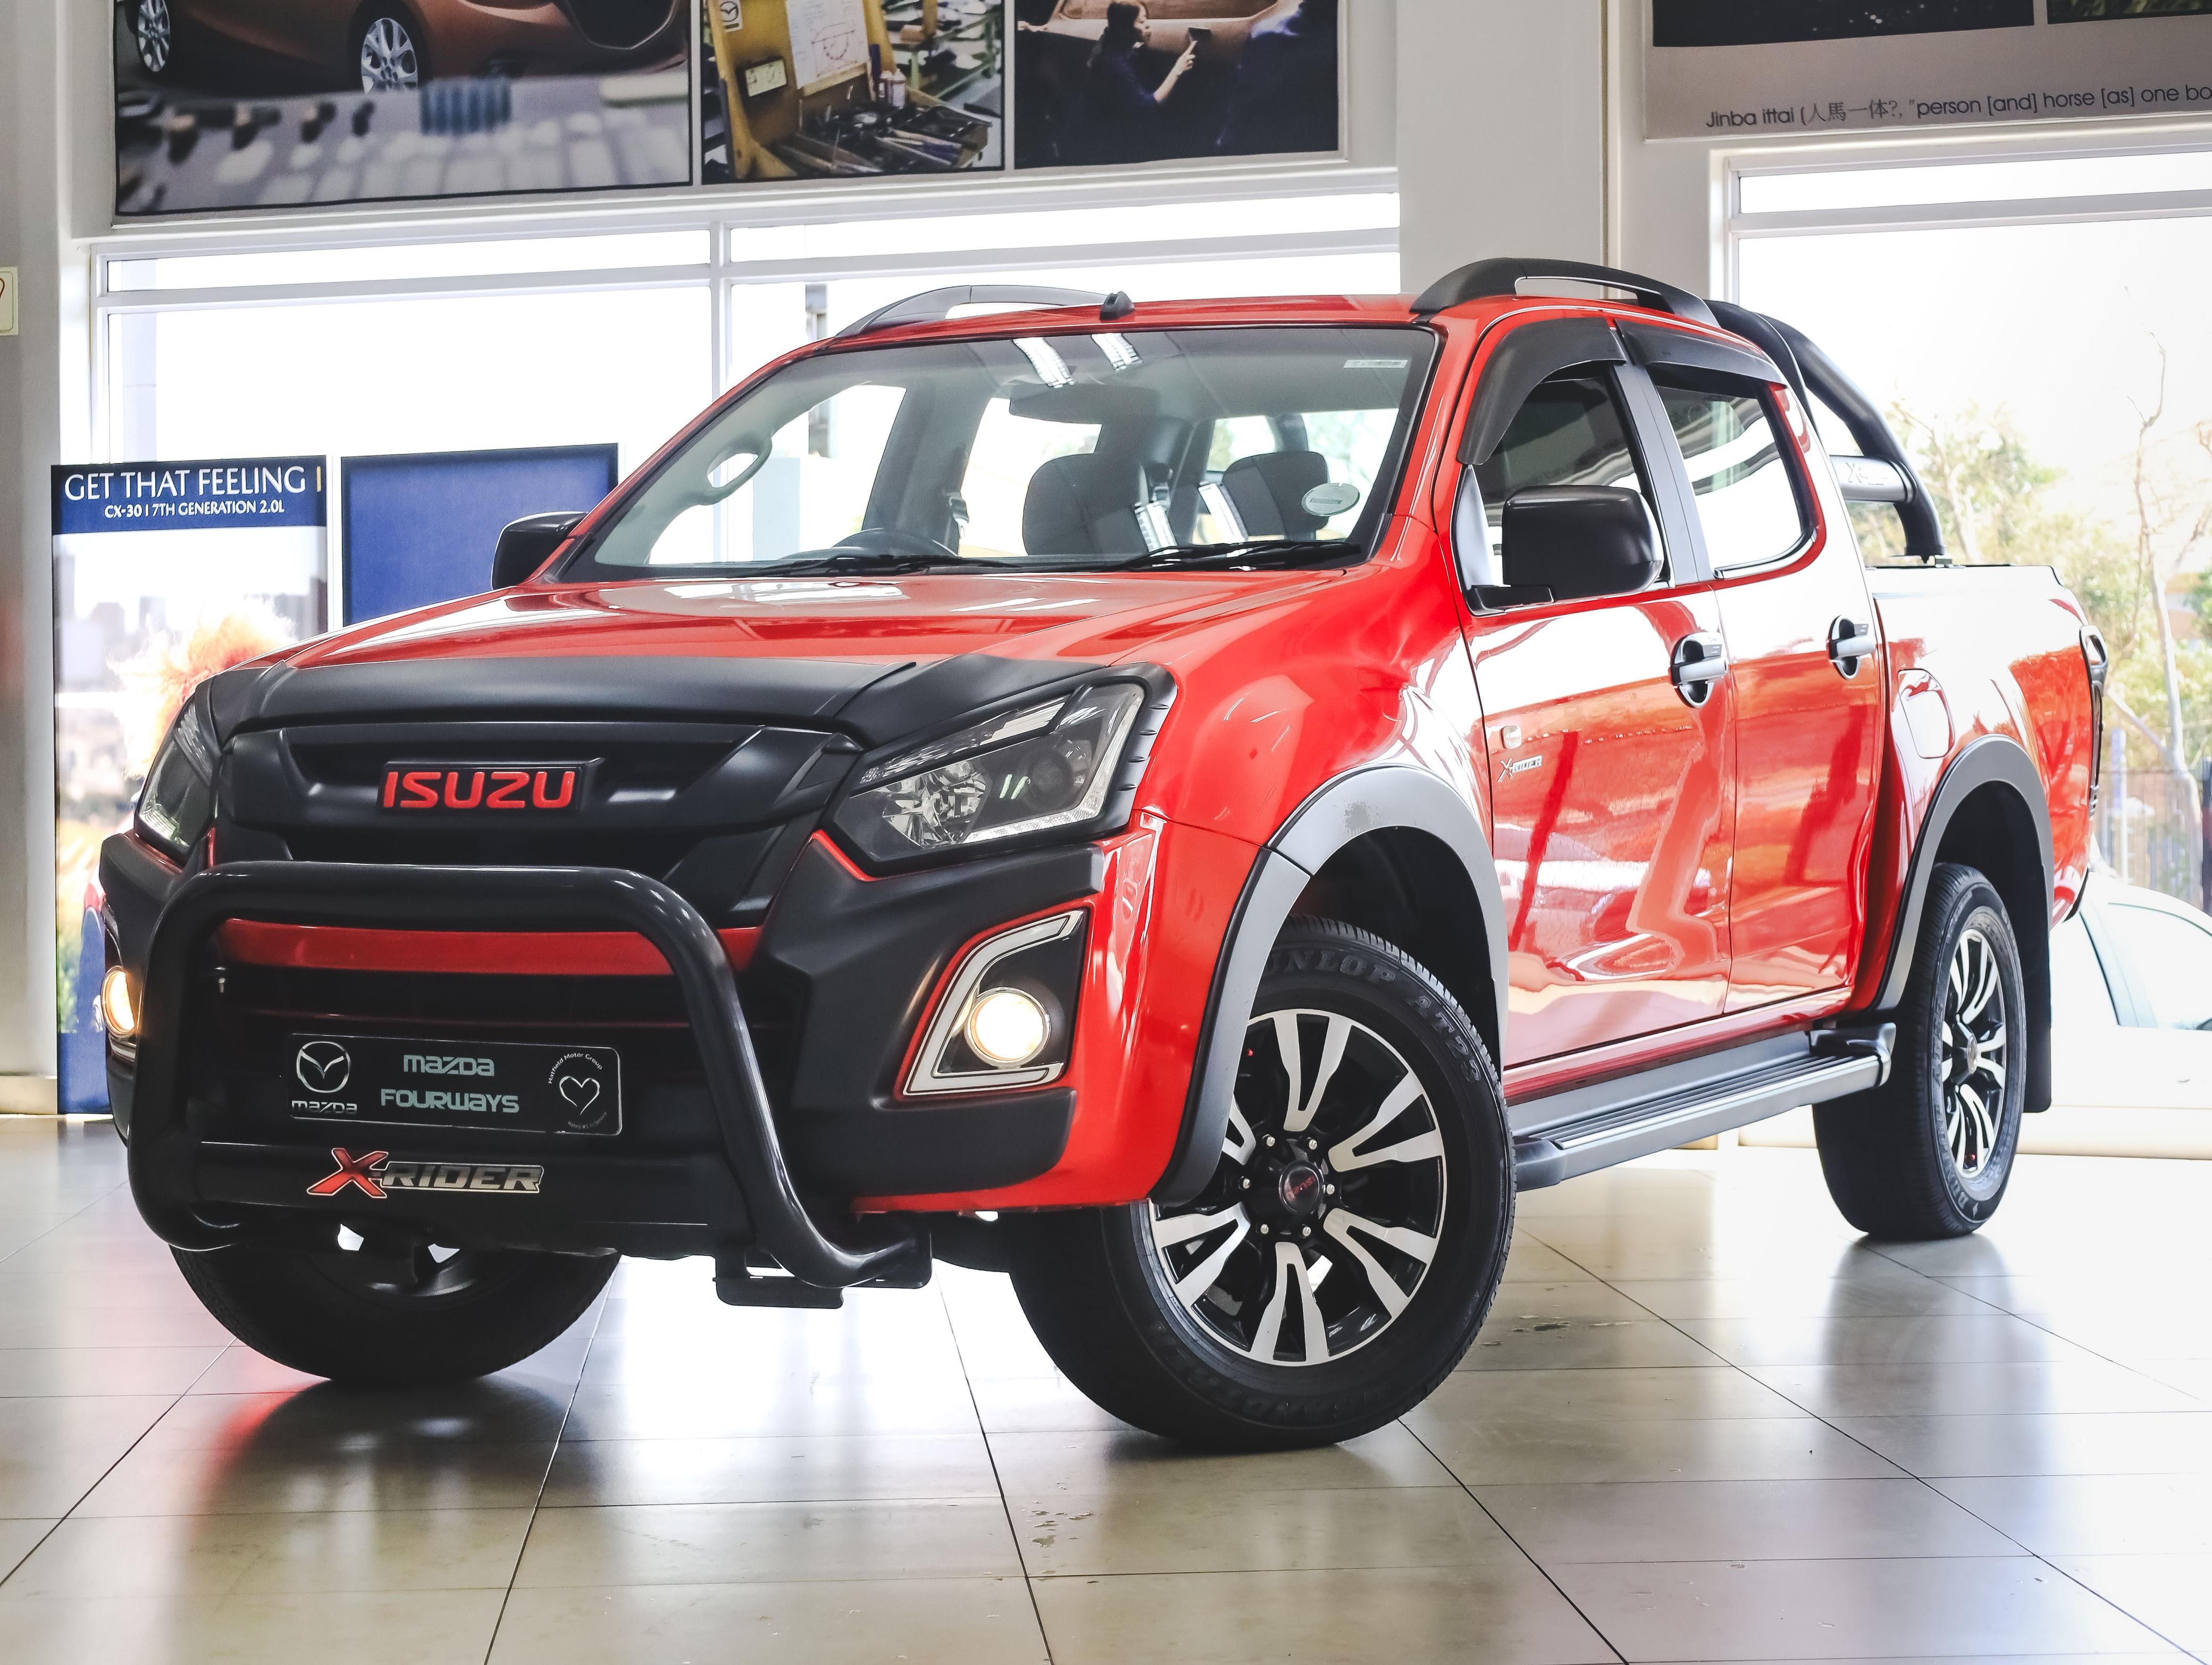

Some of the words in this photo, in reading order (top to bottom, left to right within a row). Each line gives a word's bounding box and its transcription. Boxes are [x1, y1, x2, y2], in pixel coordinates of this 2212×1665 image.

[1706, 110, 1757, 128] Jinba
[1762, 107, 1795, 124] ittai
[1987, 93, 2038, 116] [and]
[2043, 93, 2096, 108] horse
[2101, 86, 2135, 108] [as]
[2141, 87, 2179, 103] one
[64, 472, 114, 501] GET
[120, 469, 190, 499] THAT
[198, 465, 306, 497] FEELING
[104, 502, 140, 519] CX-30
[152, 502, 175, 517] 7TH
[178, 500, 256, 516] GENERATION
[259, 499, 286, 514] 2.0L
[383, 771, 575, 809] ISUZU
[1264, 949, 1396, 983] UNLOP
[548, 1058, 564, 1084] Hatfield
[585, 1054, 602, 1070] Group
[307, 1148, 544, 1199] X-RIDER
